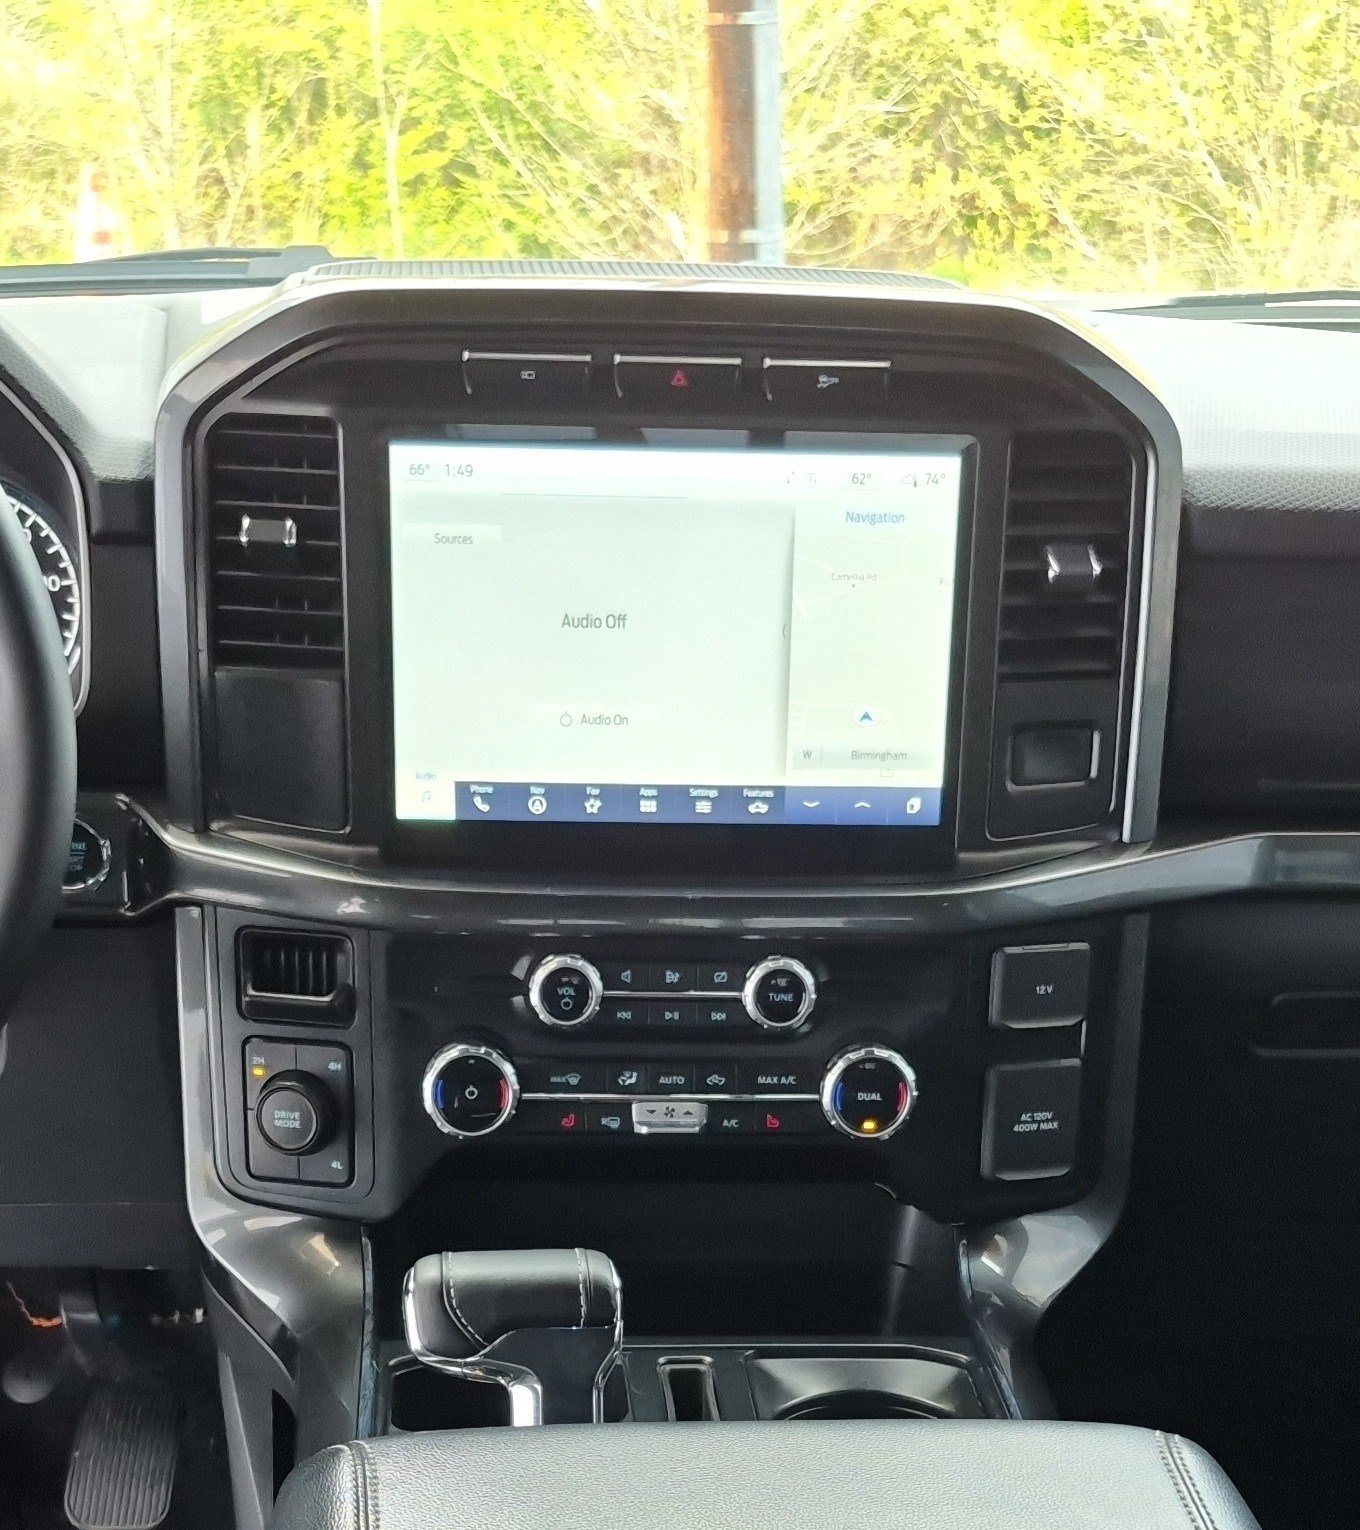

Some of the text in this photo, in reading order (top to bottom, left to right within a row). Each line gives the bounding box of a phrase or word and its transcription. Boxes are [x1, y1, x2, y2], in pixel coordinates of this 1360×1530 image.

[445, 464, 474, 477] 1:49
[845, 511, 905, 525] Navigation
[434, 533, 474, 545] Sources
[561, 612, 627, 629] Audio Off
[580, 713, 628, 726] Audio On
[803, 751, 812, 759] W
[851, 751, 908, 762] Birmingham
[470, 785, 494, 794] Phone
[640, 788, 658, 797] Apps
[690, 788, 719, 799] Settings
[743, 789, 774, 798] Features
[557, 987, 576, 996] VOL
[769, 993, 794, 1002] TUNE
[252, 1056, 265, 1065] 2H
[327, 1061, 342, 1071] 4H
[659, 1076, 685, 1085] AUTO
[758, 1075, 797, 1085] MAX A/C
[858, 1092, 882, 1102] DUAL
[274, 1110, 300, 1120] DRIVE
[1021, 1112, 1053, 1122] AC 120V
[274, 1119, 301, 1129] MODE
[723, 1118, 739, 1129] A/C
[1013, 1122, 1059, 1132] 400W MAX
[331, 1161, 343, 1170] 4L
